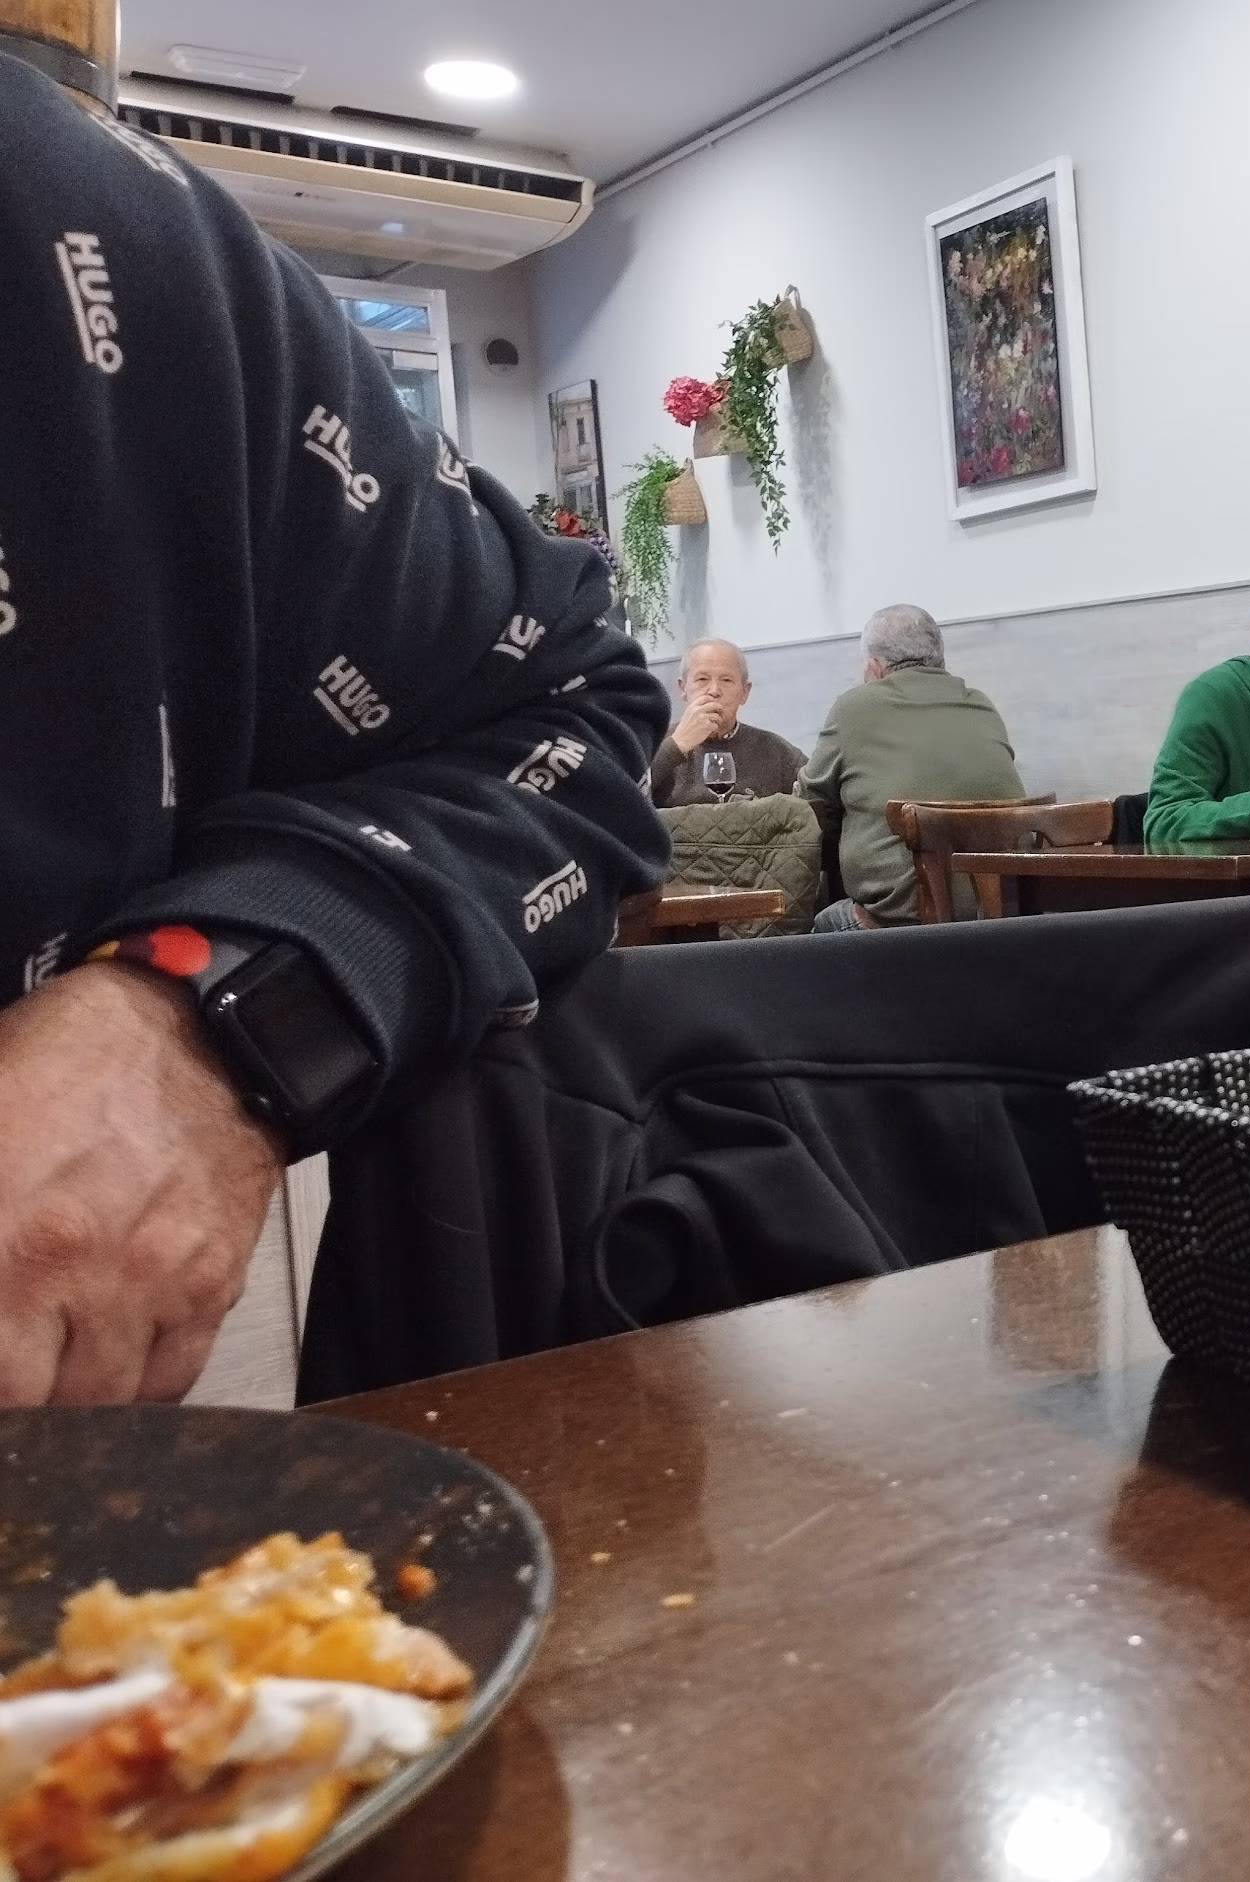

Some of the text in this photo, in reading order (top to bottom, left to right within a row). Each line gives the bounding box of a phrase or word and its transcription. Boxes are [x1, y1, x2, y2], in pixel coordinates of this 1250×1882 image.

[63, 231, 124, 374] HUGO
[318, 654, 392, 730] HUGO
[524, 866, 588, 934] HUGO
